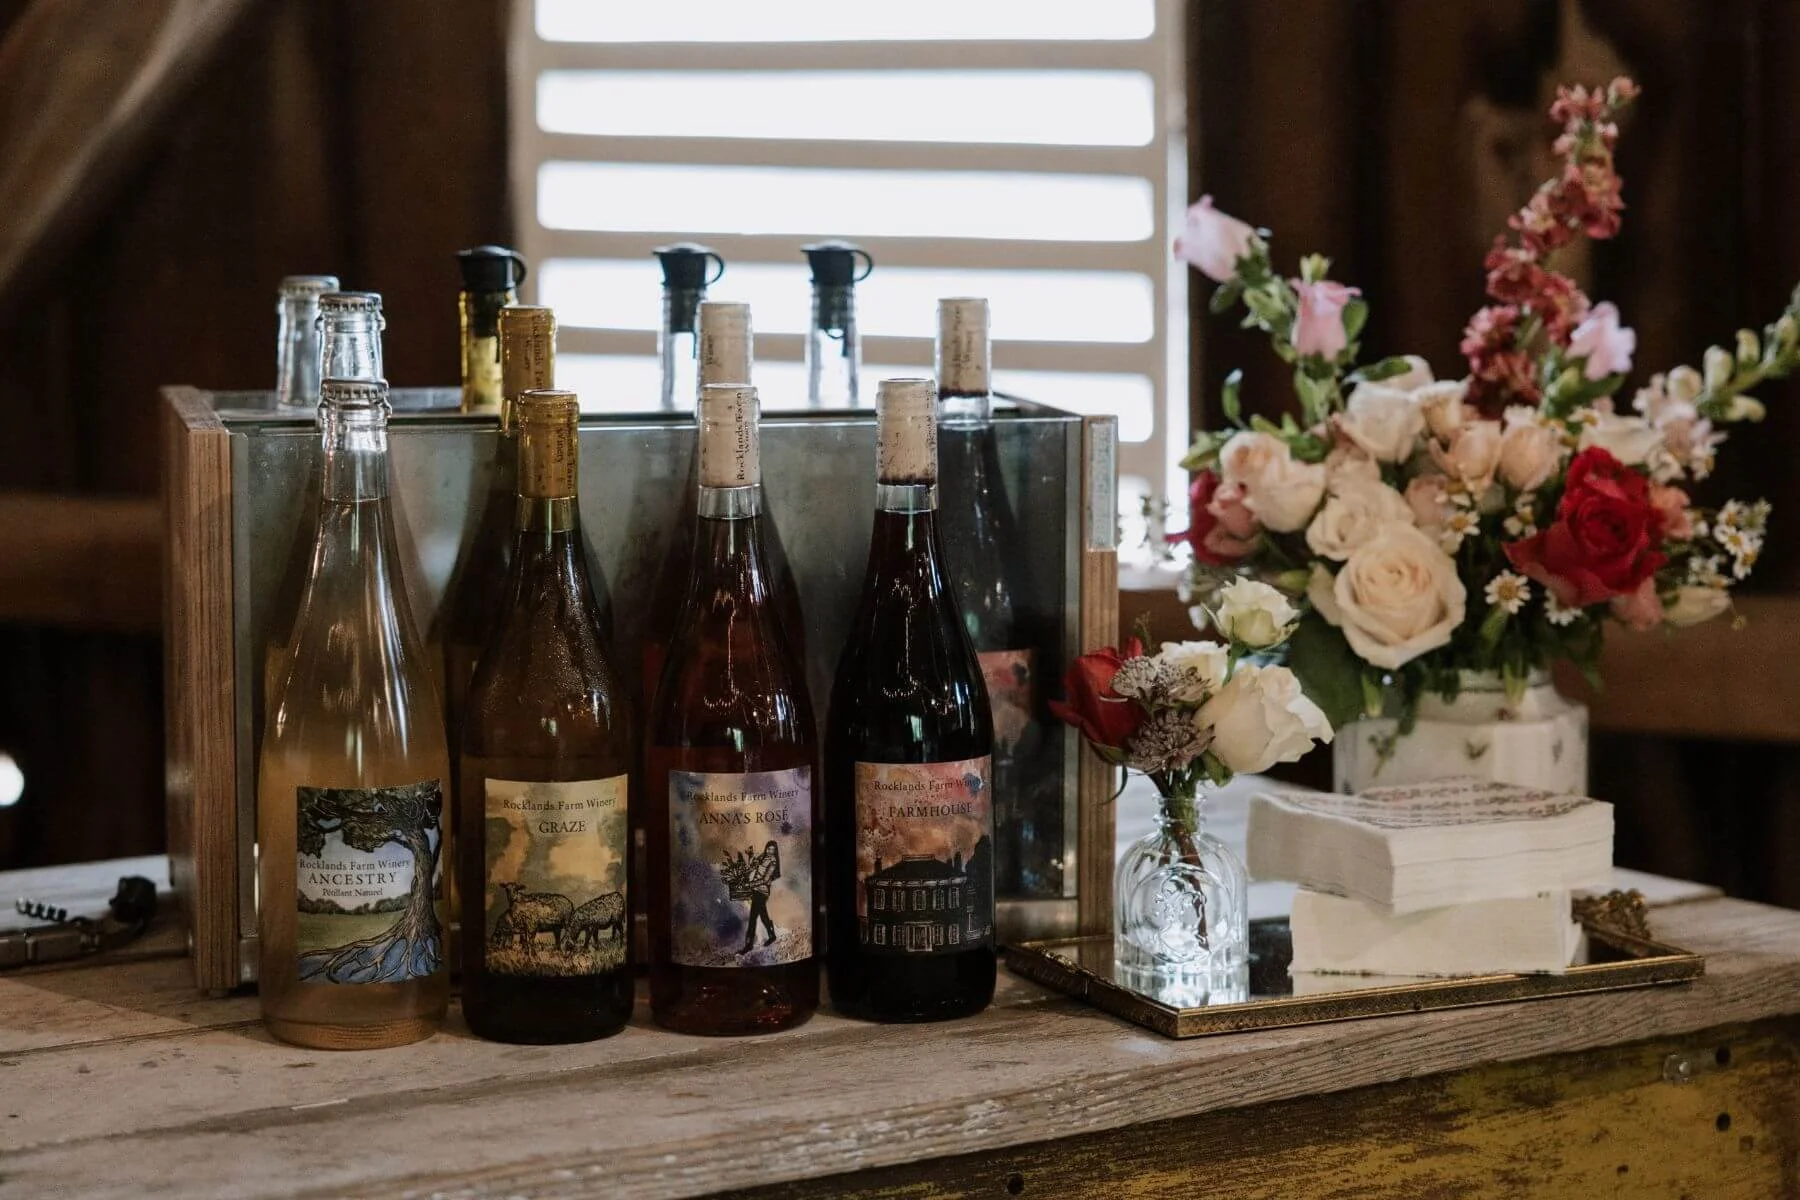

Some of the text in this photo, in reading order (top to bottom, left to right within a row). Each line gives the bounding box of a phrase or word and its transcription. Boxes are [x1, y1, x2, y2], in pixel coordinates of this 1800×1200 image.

[874, 780, 926, 792] Rocklands
[929, 780, 953, 791] Farm
[768, 789, 799, 800] Winery
[503, 797, 617, 811] Rocklands Farm Winery
[889, 802, 973, 818] FARMHOUSE
[700, 806, 789, 825] ANNA'S ROSÉ
[538, 820, 588, 834] GRAZE
[300, 859, 409, 871] Rocklands Farm Winery
[308, 871, 397, 886] ANCESTRY
